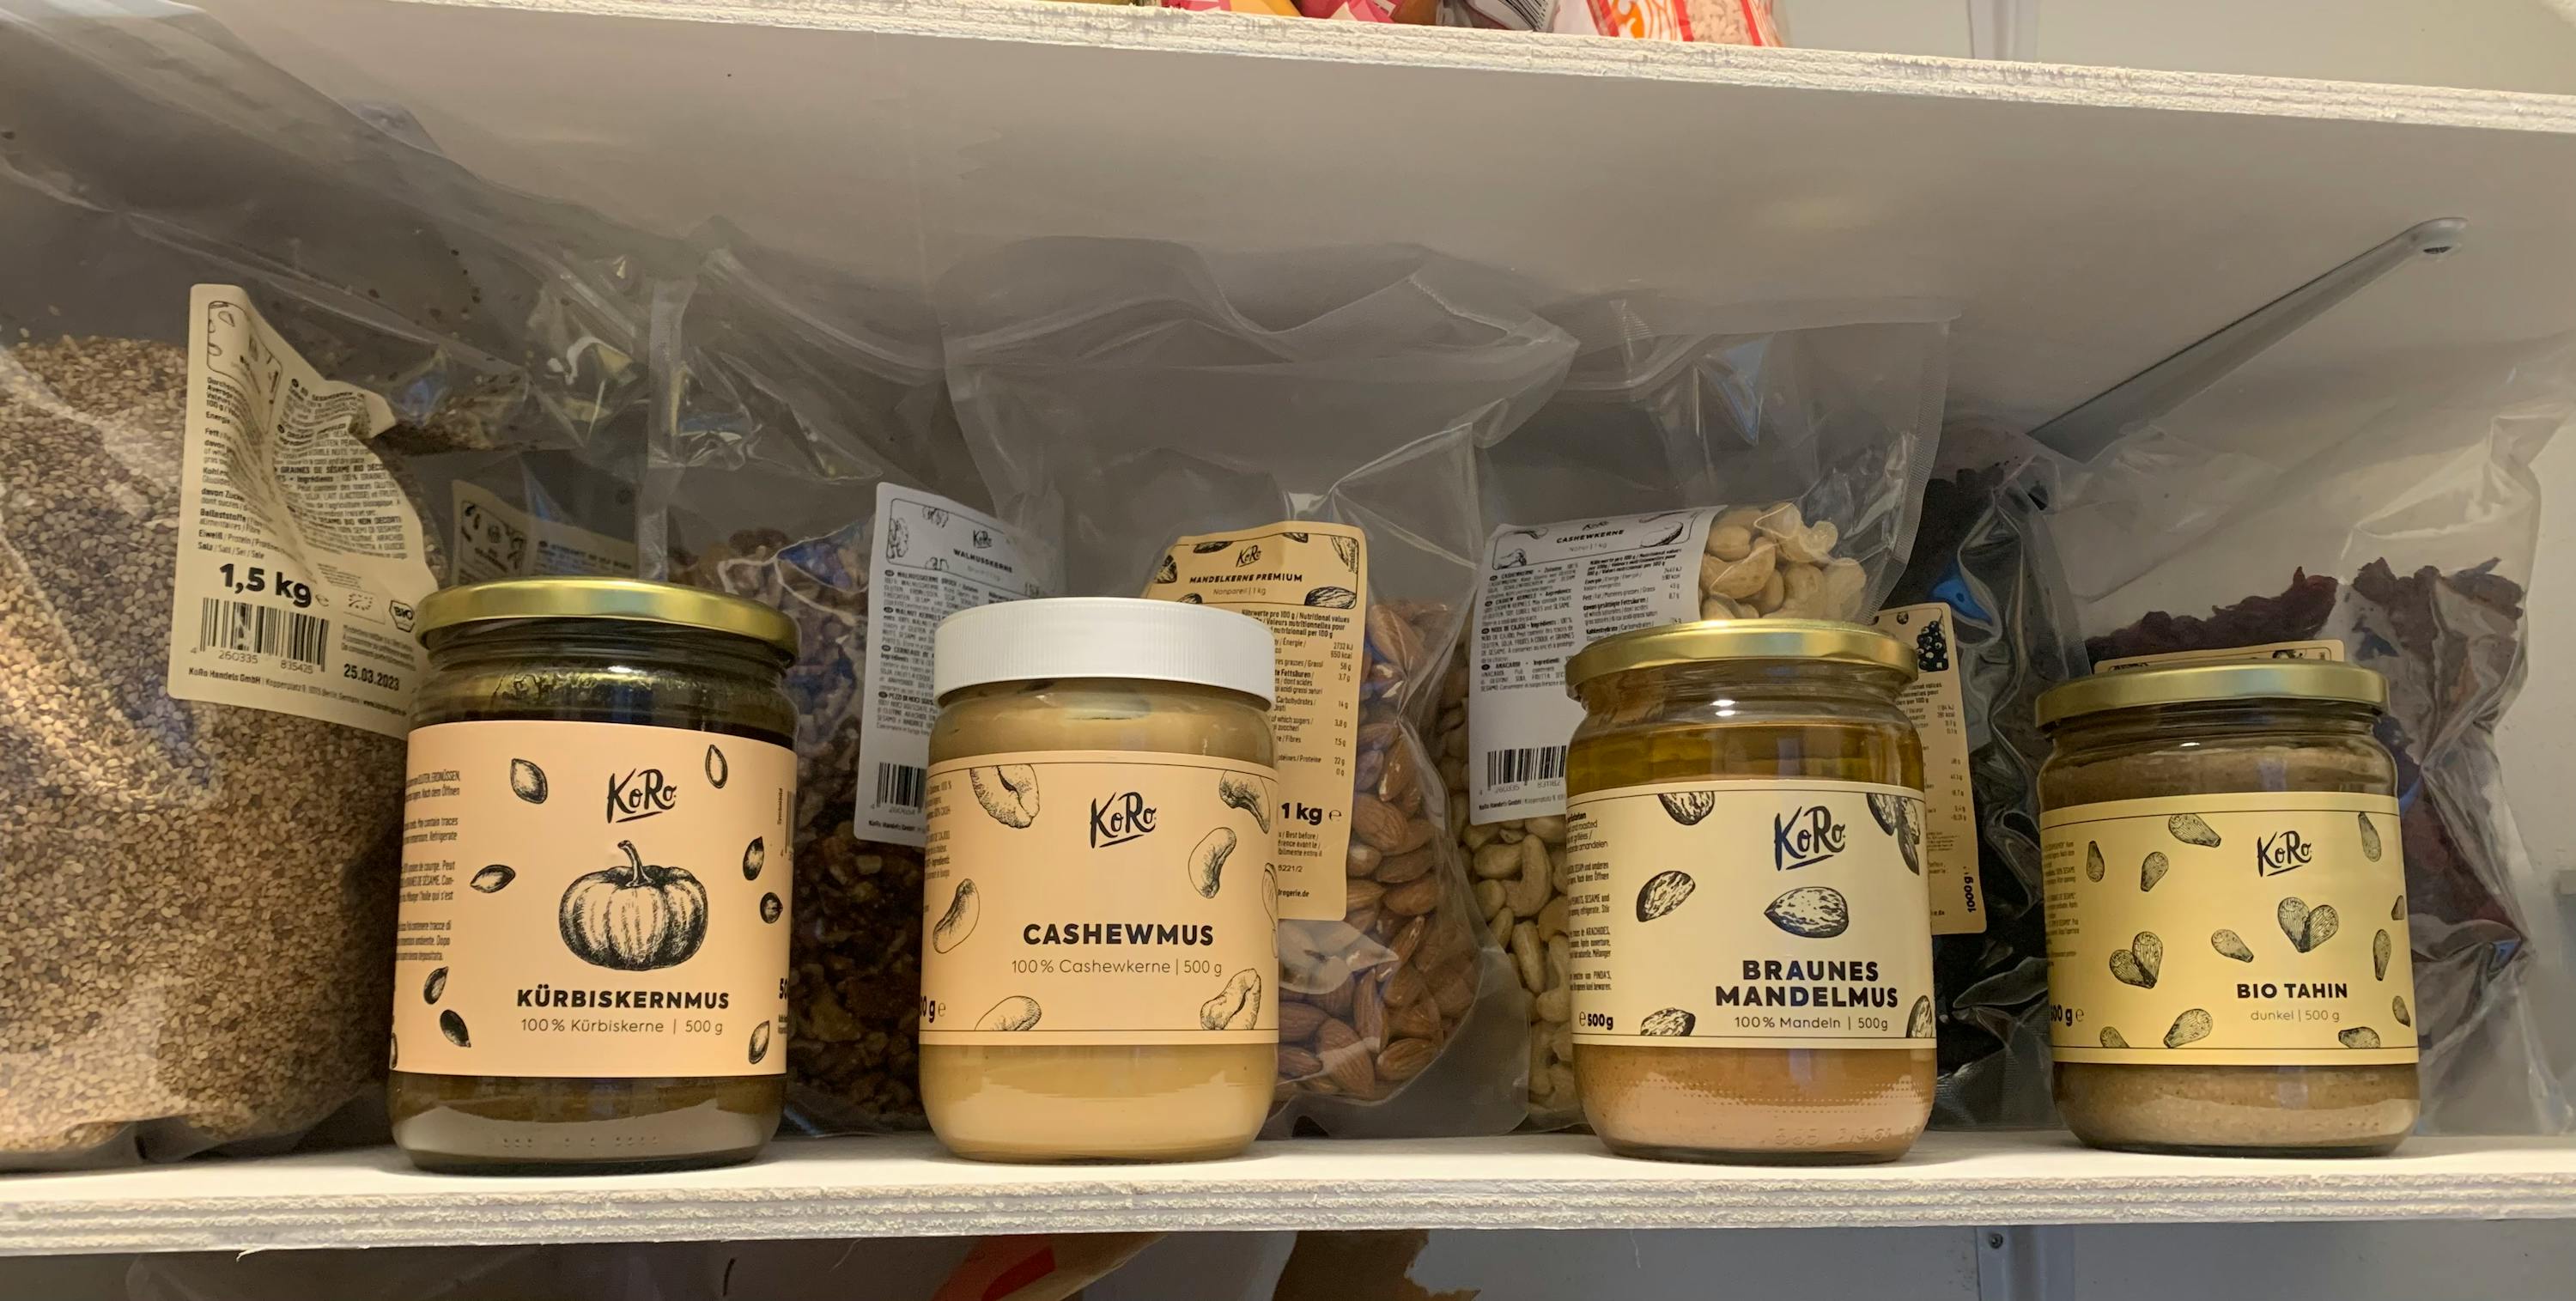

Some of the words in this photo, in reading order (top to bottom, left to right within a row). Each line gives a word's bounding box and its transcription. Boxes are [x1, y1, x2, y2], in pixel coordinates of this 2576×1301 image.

[1556, 530, 1625, 544] CASHEWKERNE
[953, 548, 1012, 573] WALNUSSKERNE
[1236, 544, 1261, 568] KoRo
[219, 563, 265, 594] 1,5
[276, 571, 312, 607] kg
[1189, 573, 1254, 584] MANDELKERNE
[1255, 572, 1303, 583] PREMIUM
[1213, 587, 1247, 596] Nonpareil
[1257, 587, 1267, 596] kg
[1289, 620, 1331, 629] nutritionnelles
[1299, 612, 1331, 621] Nutritional
[1273, 627, 1306, 635] nutrizionali
[1283, 637, 1303, 648] Énergie
[218, 650, 258, 664] 260335
[1285, 659, 1303, 667] grasses
[189, 667, 209, 678] KoRo
[210, 670, 239, 683] Handels
[240, 674, 261, 684] GmbH
[343, 664, 399, 690] 25.03.2023
[1280, 669, 1311, 678] Fettsäuren
[606, 768, 677, 824] KoRo
[1090, 791, 1157, 848] KoRo
[1281, 802, 1290, 818] 1
[1297, 802, 1322, 825] kg
[1298, 831, 1315, 840] before
[1774, 806, 1845, 871] KoRo
[2257, 830, 2312, 877] KoRo
[1024, 923, 1213, 945] CASHEWMUS
[1012, 959, 1054, 974] 100%
[1060, 959, 1170, 974] Cashewkerne
[1184, 960, 1210, 974] 500
[1214, 964, 1222, 976] g
[1742, 960, 1879, 982] BRAUNES
[517, 984, 729, 1009] KÜRBISKERNMUS
[1716, 986, 1898, 1008] MANDELMUS
[2237, 983, 2277, 999] BIO
[2284, 982, 2348, 999] TAHIN
[928, 998, 936, 1024] g
[2065, 1007, 2073, 1027] g
[2251, 1008, 2294, 1021] dunkel
[2306, 1009, 2329, 1021] 500
[2331, 1012, 2340, 1023] g
[521, 1018, 565, 1032] 100%
[571, 1018, 664, 1033] Kürbiskerne
[685, 1019, 710, 1033] 500
[714, 1022, 723, 1036] g
[1735, 1016, 1777, 1029] 100%
[1780, 1016, 1841, 1029] Mandeln
